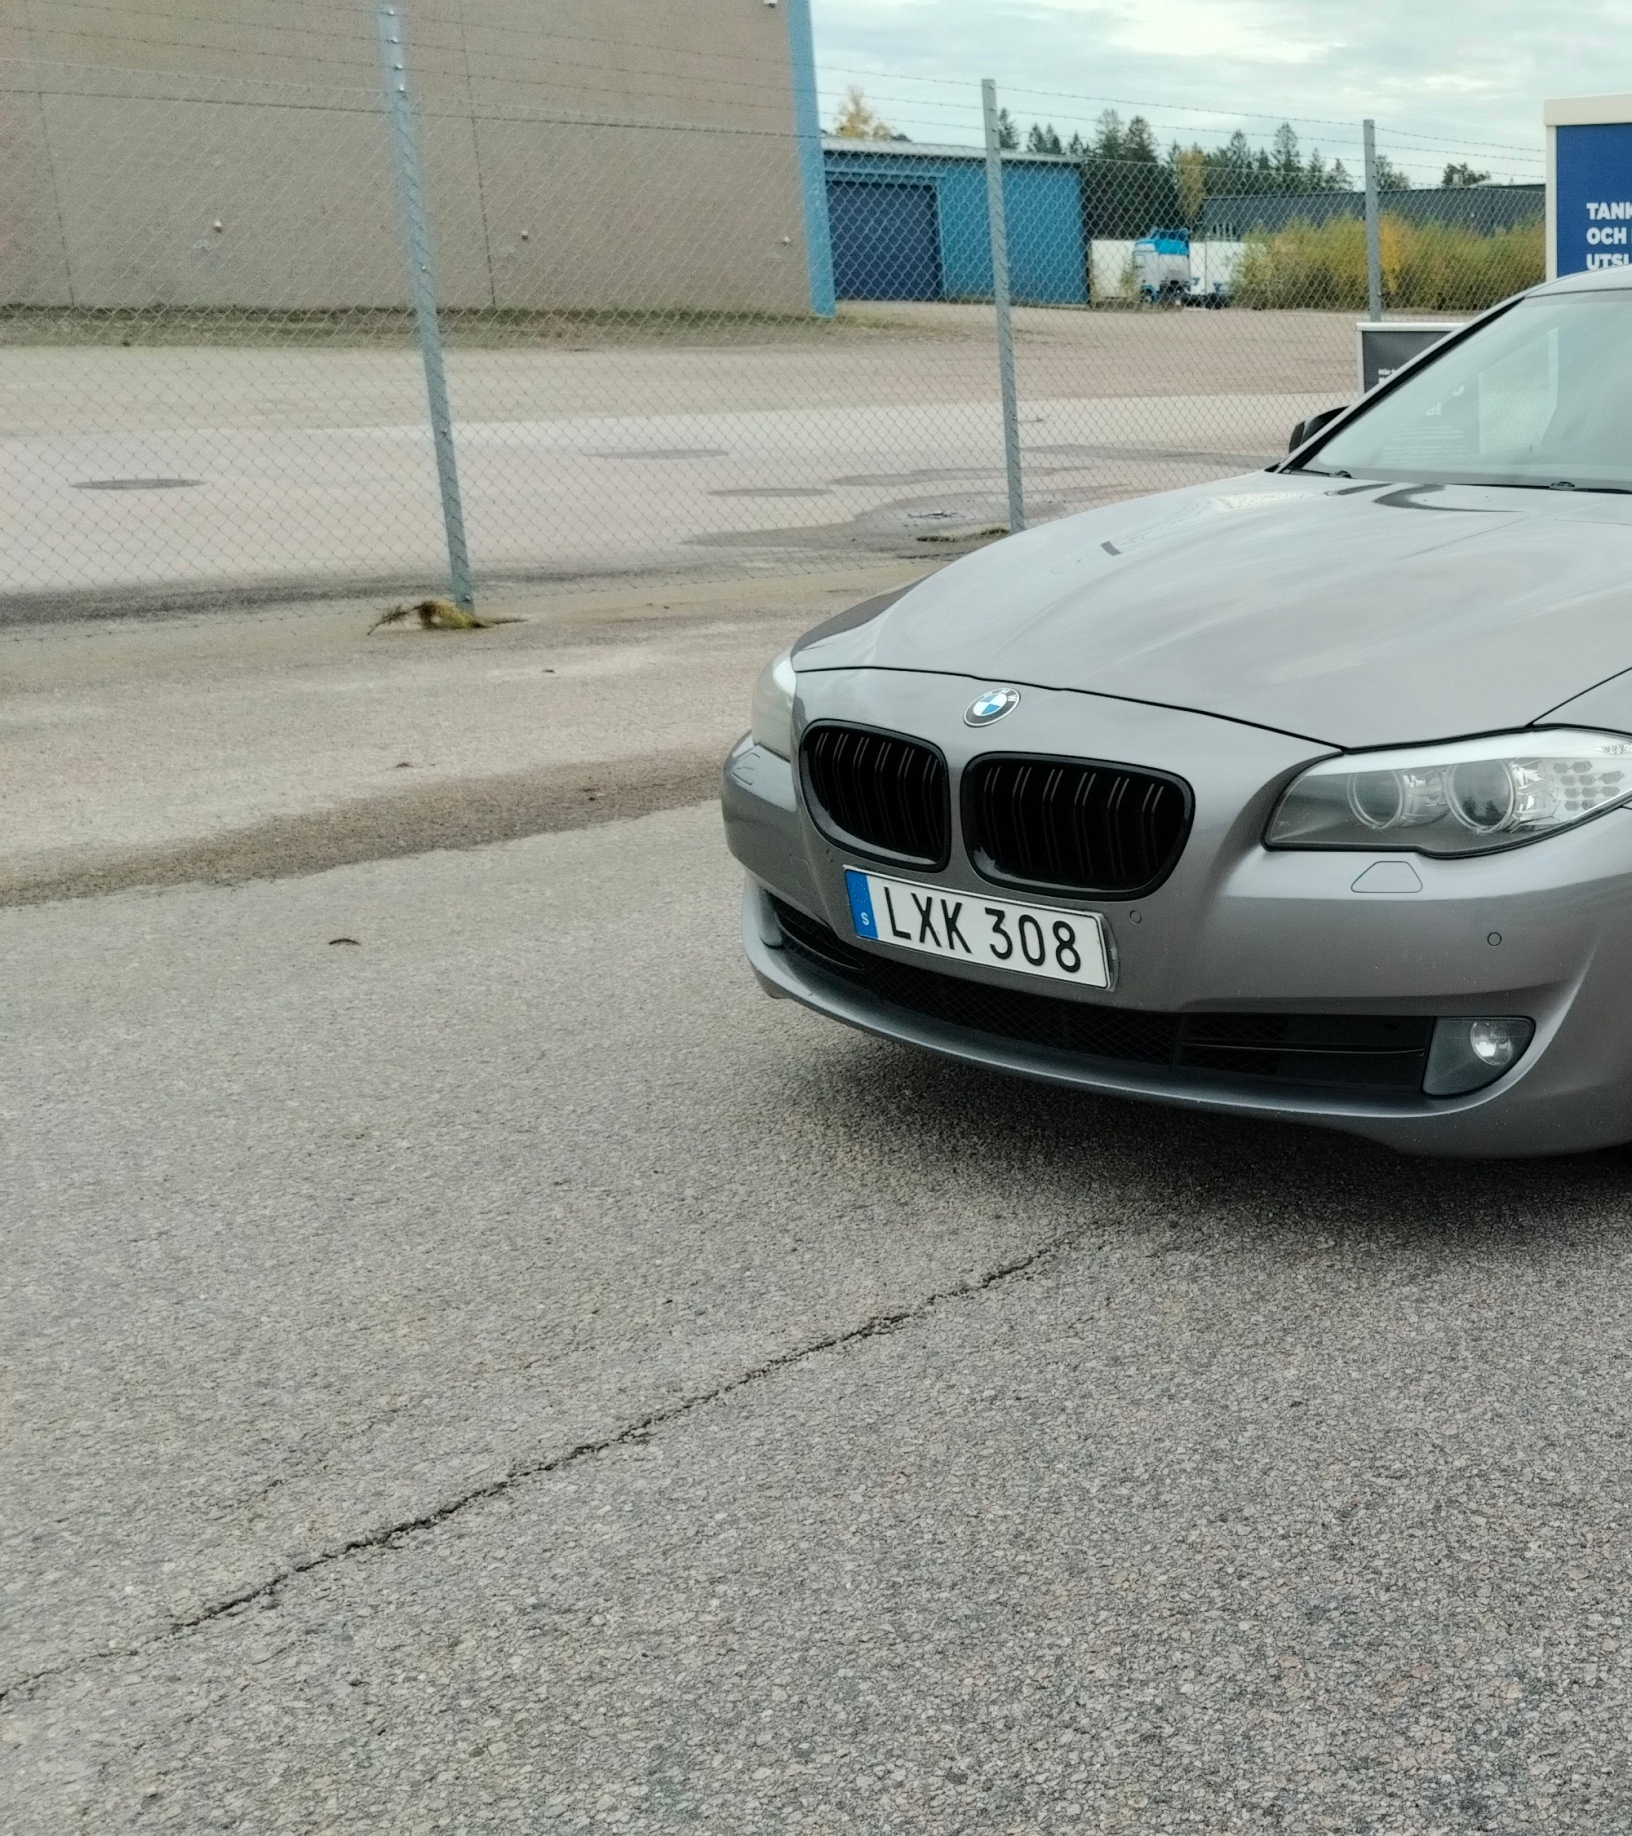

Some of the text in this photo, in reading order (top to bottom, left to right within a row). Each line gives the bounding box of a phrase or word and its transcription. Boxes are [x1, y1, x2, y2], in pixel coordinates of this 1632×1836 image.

[1586, 227, 1627, 245] OCH
[861, 912, 870, 926] S
[884, 886, 1081, 973] LXK 308
